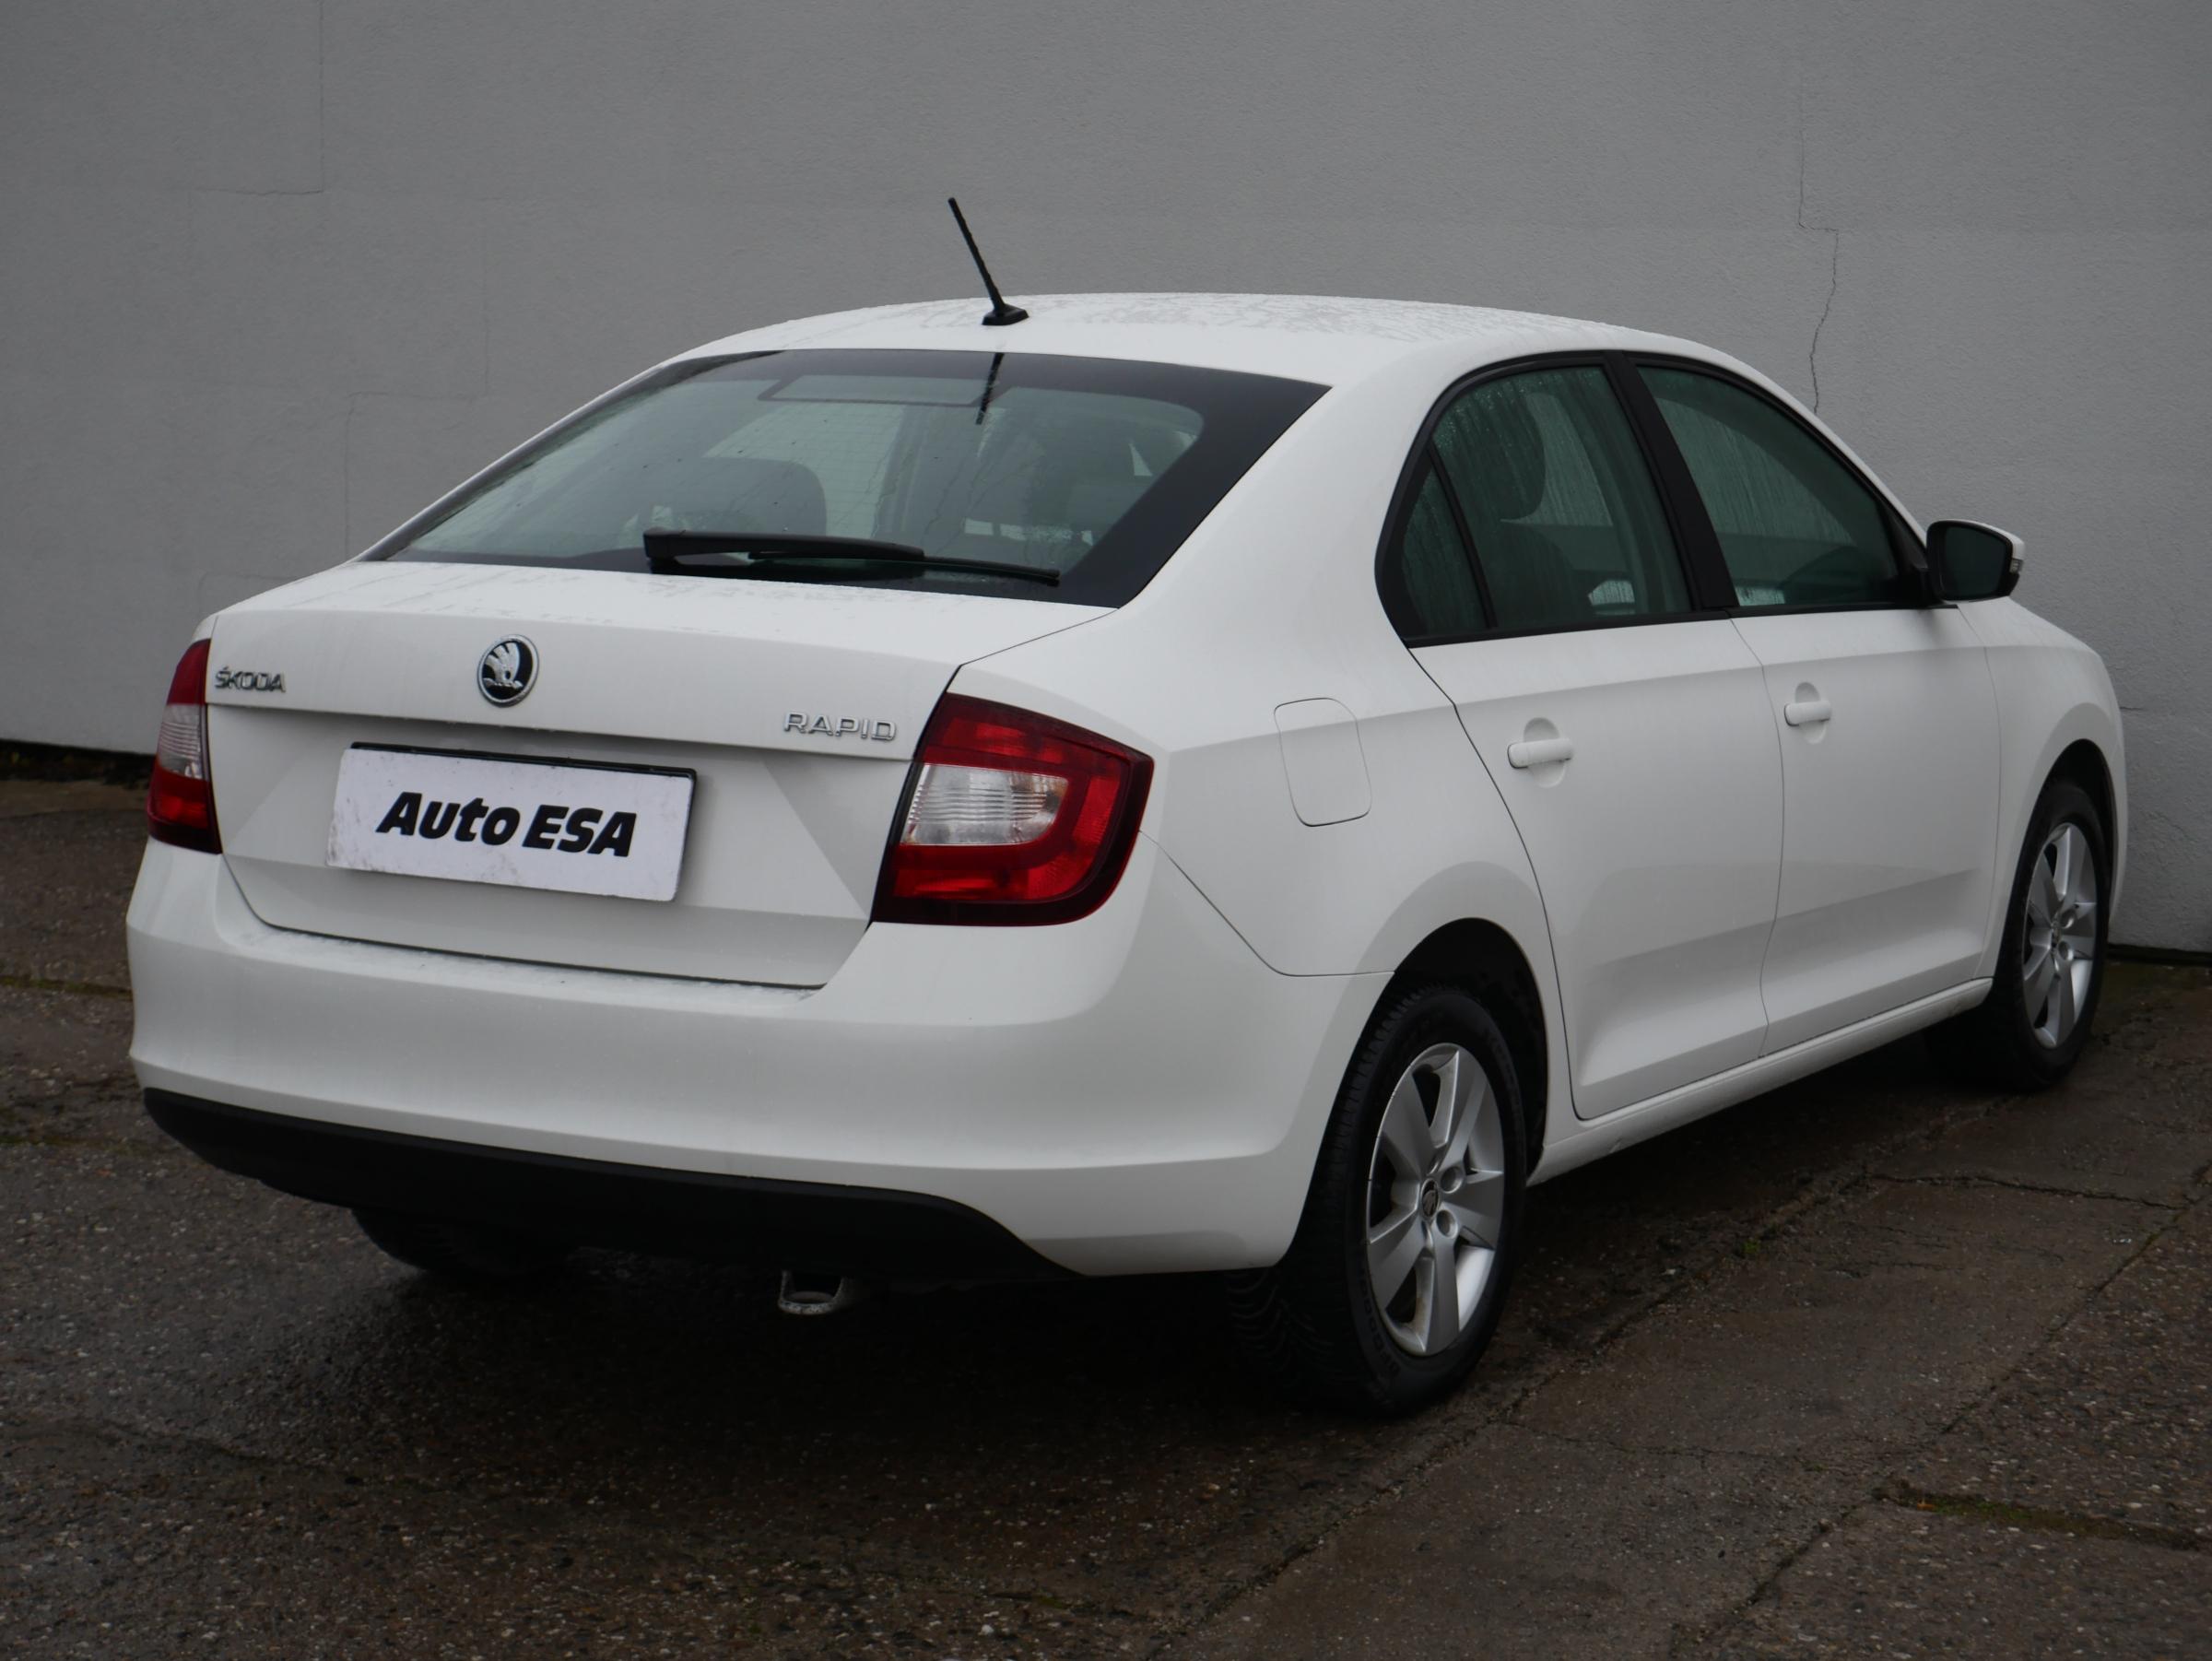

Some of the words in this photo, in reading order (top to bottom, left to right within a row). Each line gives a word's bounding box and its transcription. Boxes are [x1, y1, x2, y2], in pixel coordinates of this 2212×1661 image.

[783, 712, 897, 741] RAPID
[375, 791, 520, 845] Auto
[522, 804, 637, 857] ESA
